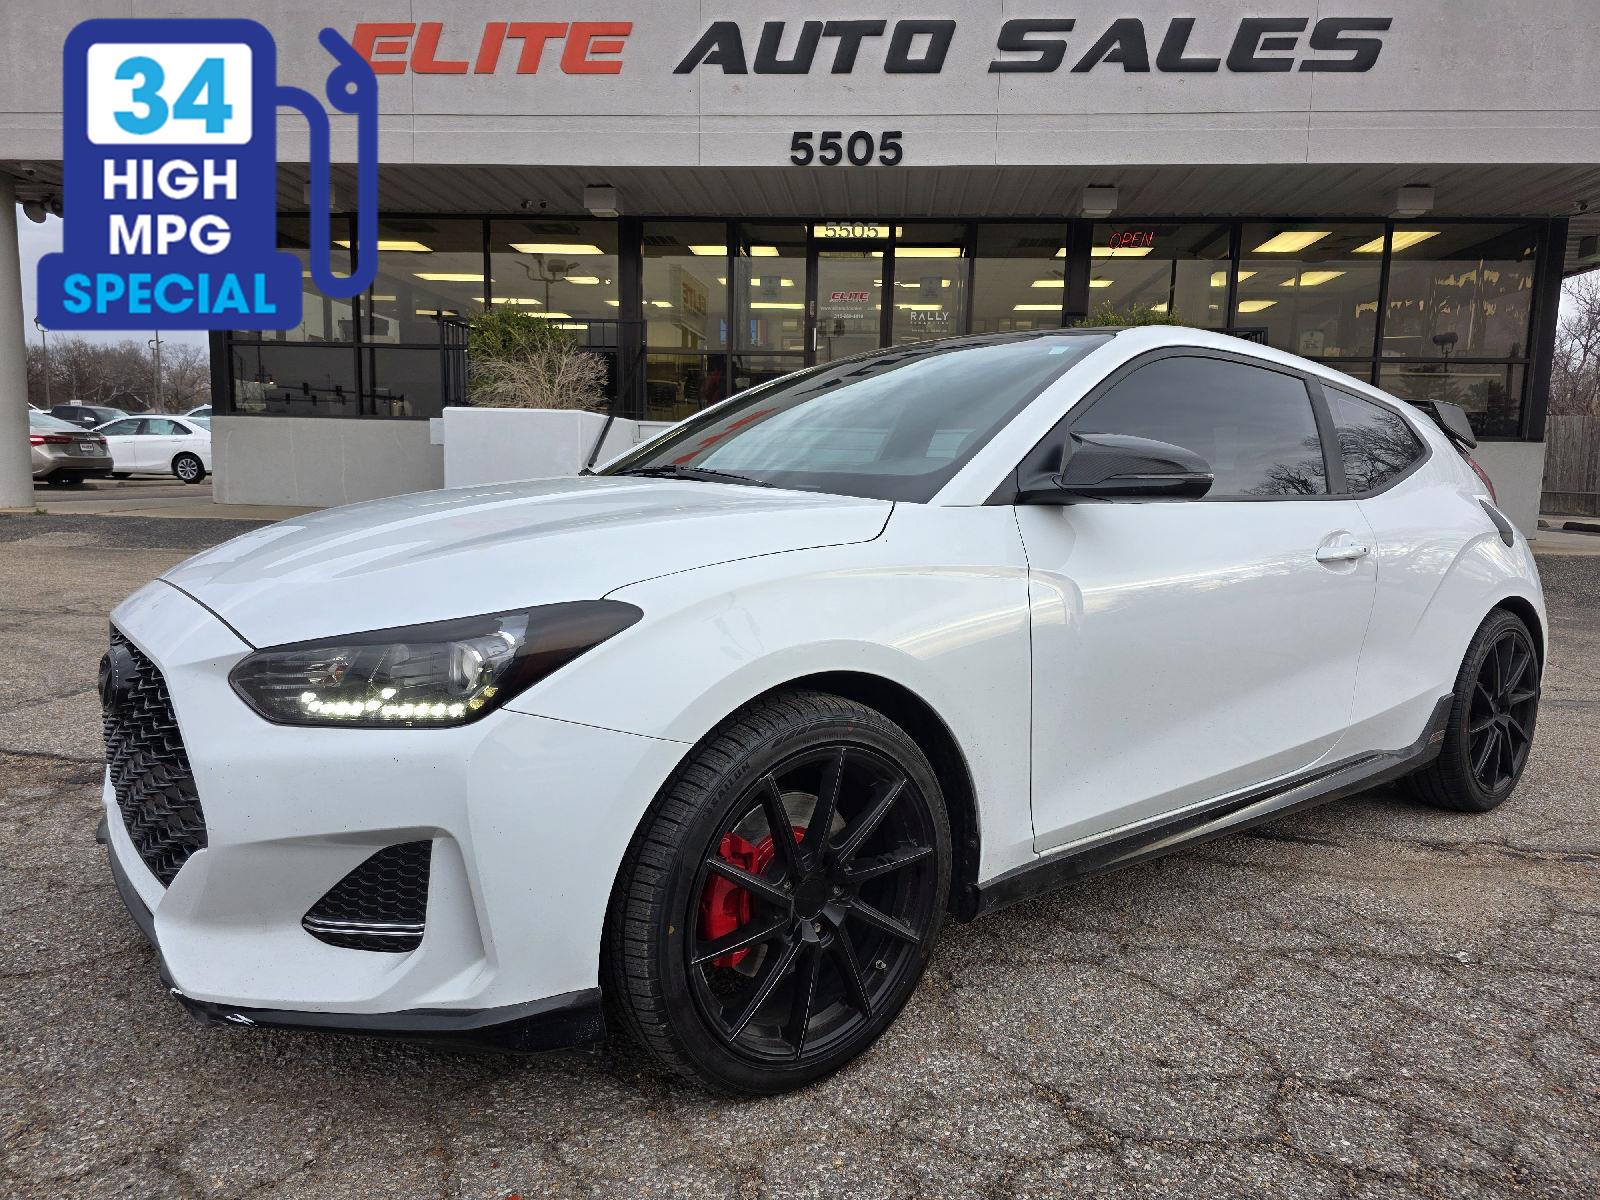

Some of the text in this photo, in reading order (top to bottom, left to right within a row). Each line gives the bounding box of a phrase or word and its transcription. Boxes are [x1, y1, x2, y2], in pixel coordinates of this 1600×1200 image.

[352, 18, 1393, 74] ELITE AUTO SALES
[790, 130, 903, 166] 5505
[825, 222, 878, 238] 5505
[1110, 231, 1154, 248] OPEN
[831, 291, 870, 300] ELITE
[910, 311, 949, 321] RALLY
